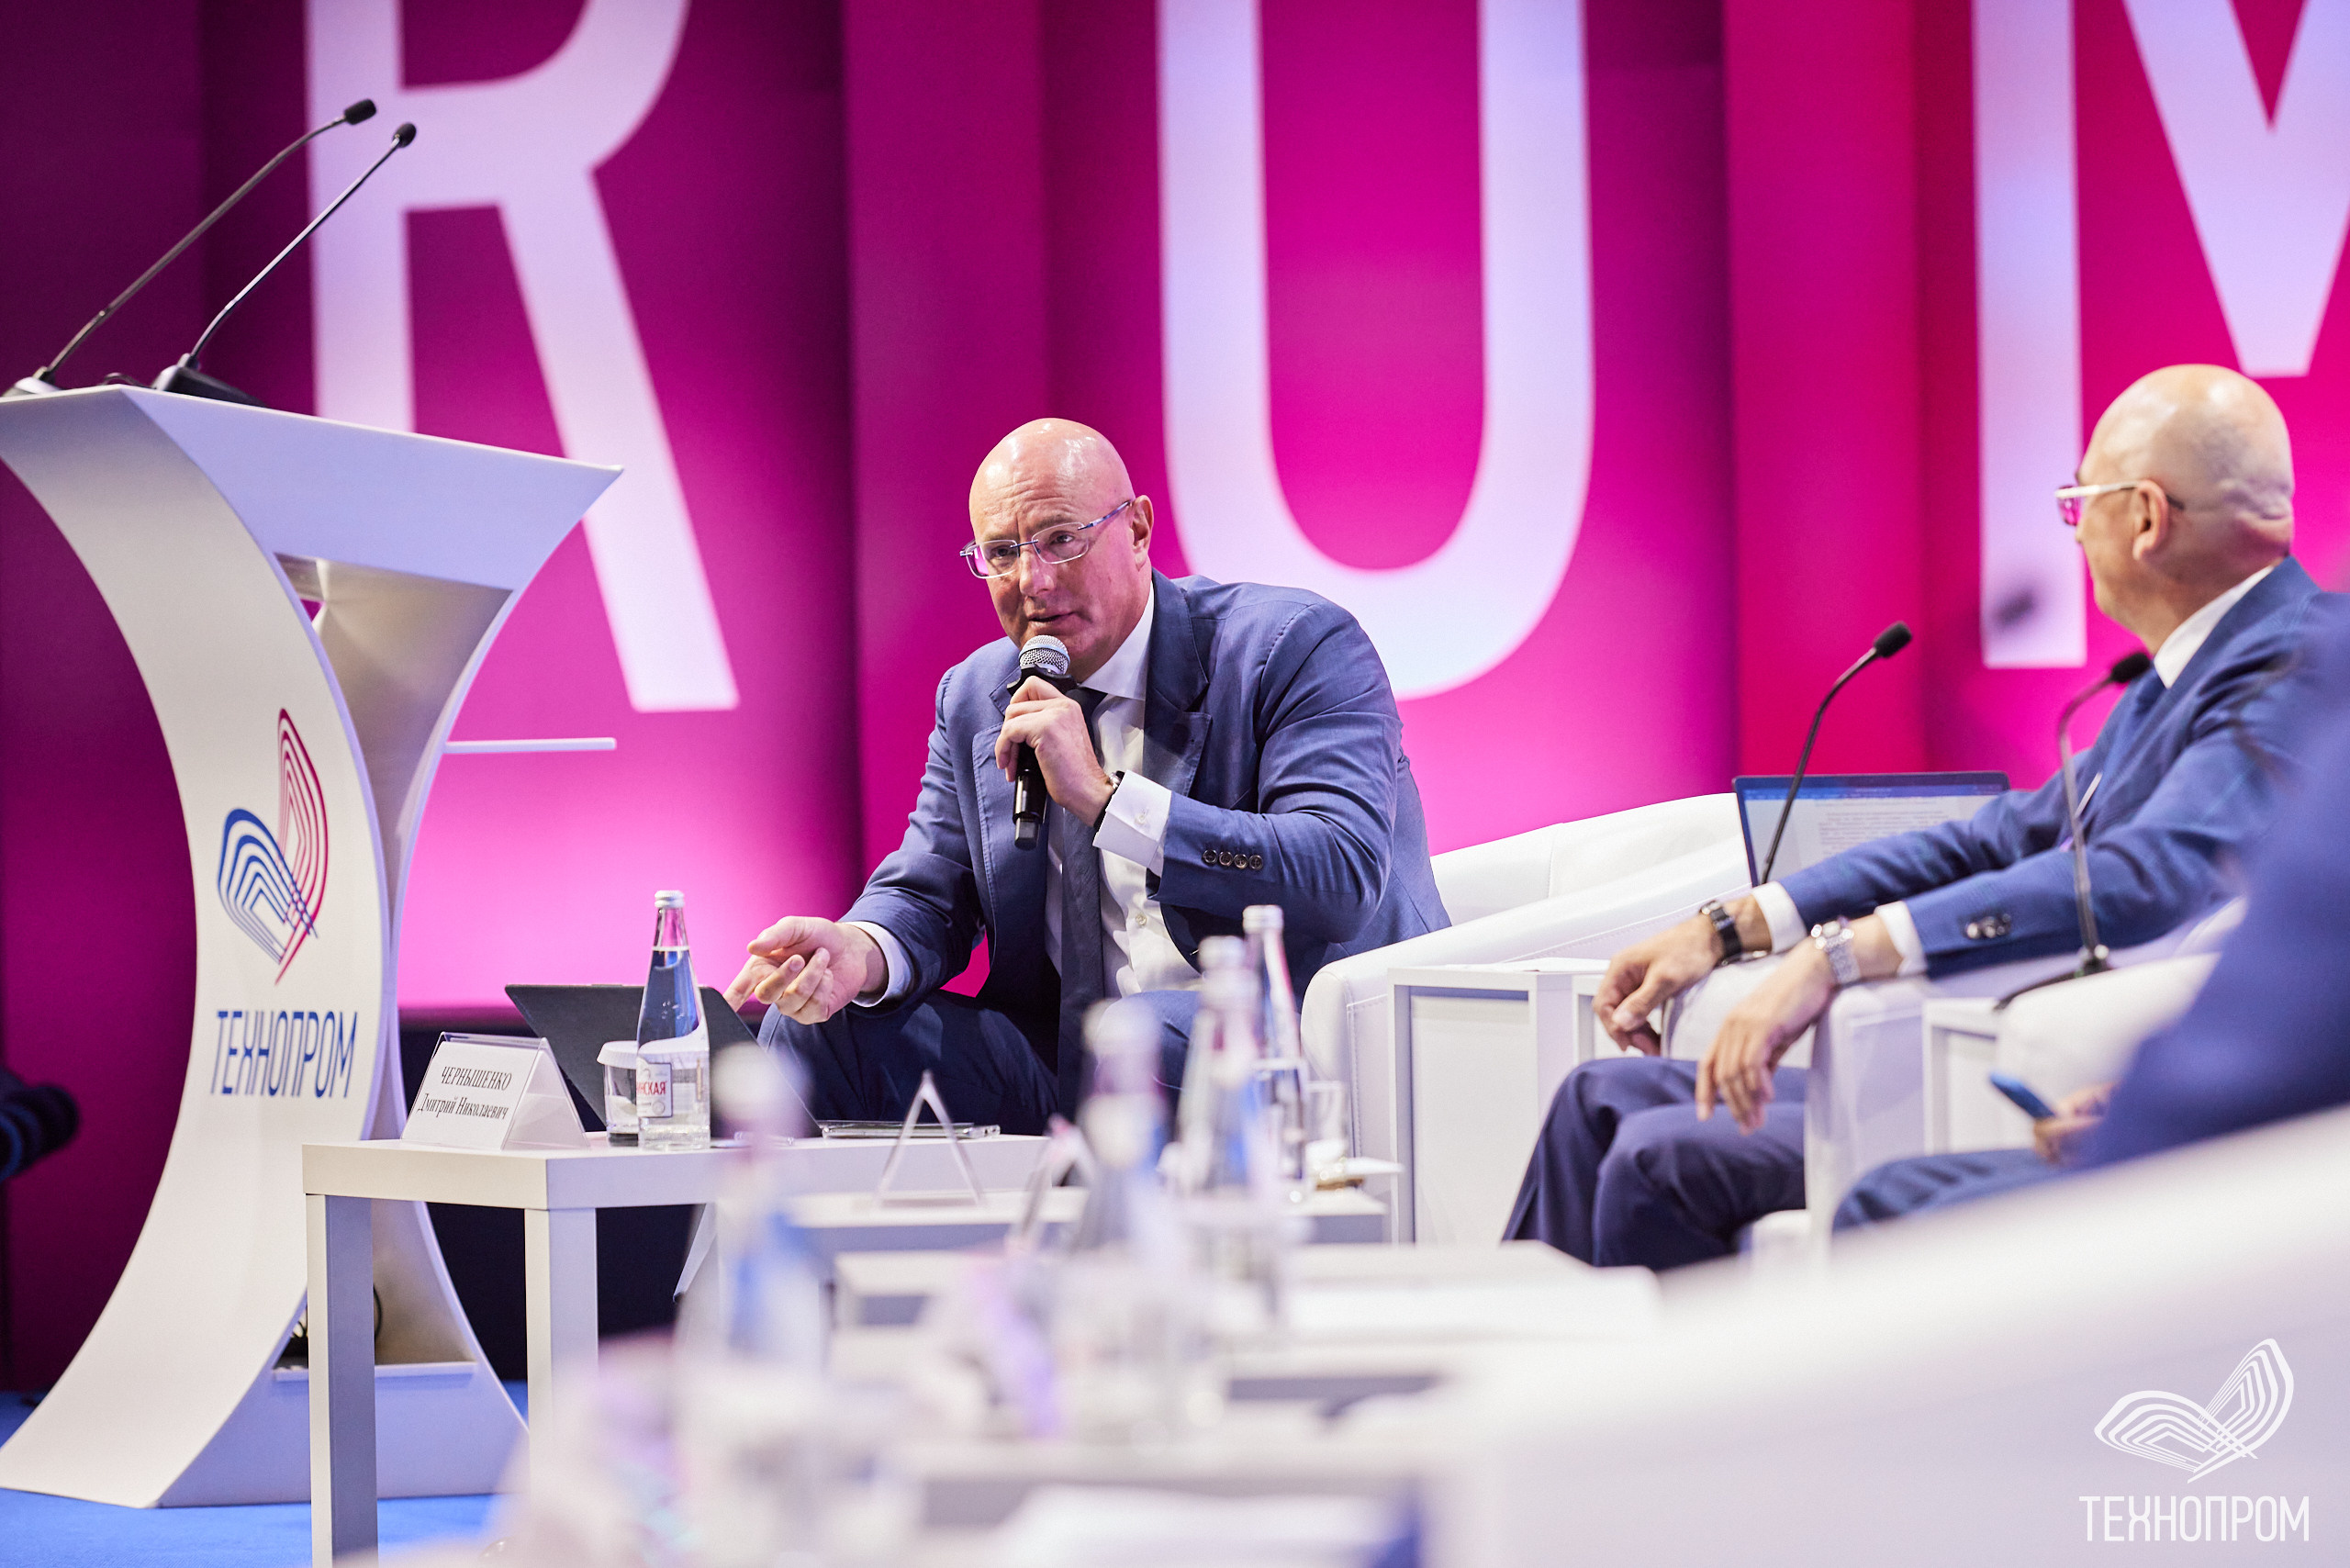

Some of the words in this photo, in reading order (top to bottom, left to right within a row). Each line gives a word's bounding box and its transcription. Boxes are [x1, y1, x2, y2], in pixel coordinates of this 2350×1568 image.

[210, 1011, 357, 1098] ТЕХНОПРОМ
[441, 1066, 512, 1092] ЧЕРНЫШЕНКО
[416, 1092, 457, 1118] Дмитрий
[455, 1096, 509, 1119] Николаевич
